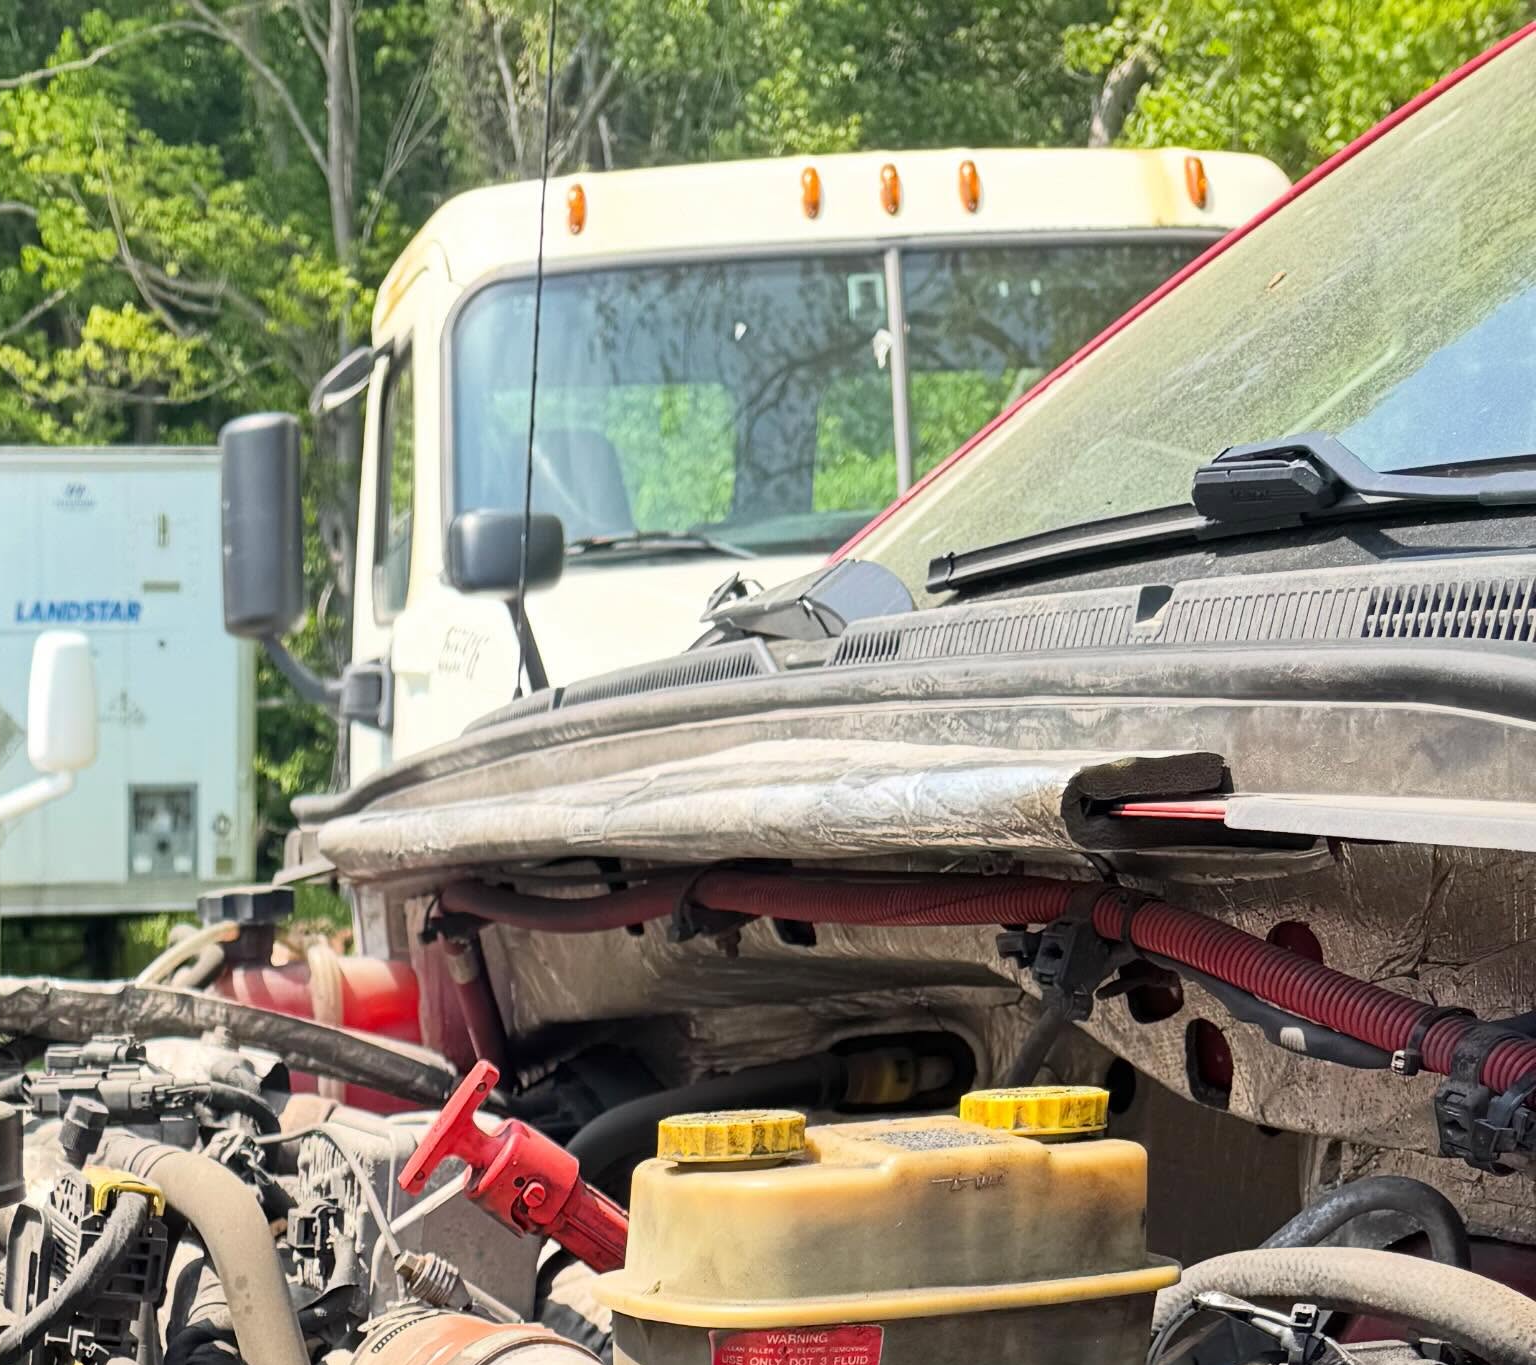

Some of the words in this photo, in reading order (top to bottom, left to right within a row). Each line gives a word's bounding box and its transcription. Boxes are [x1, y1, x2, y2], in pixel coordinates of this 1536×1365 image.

[15, 601, 141, 622] LANDSTAR
[766, 1333, 828, 1344] WARNING
[721, 1345, 745, 1353] LEAN
[721, 1354, 744, 1365] USE
[819, 1357, 828, 1365] 3
[833, 1355, 869, 1365] FLUID
